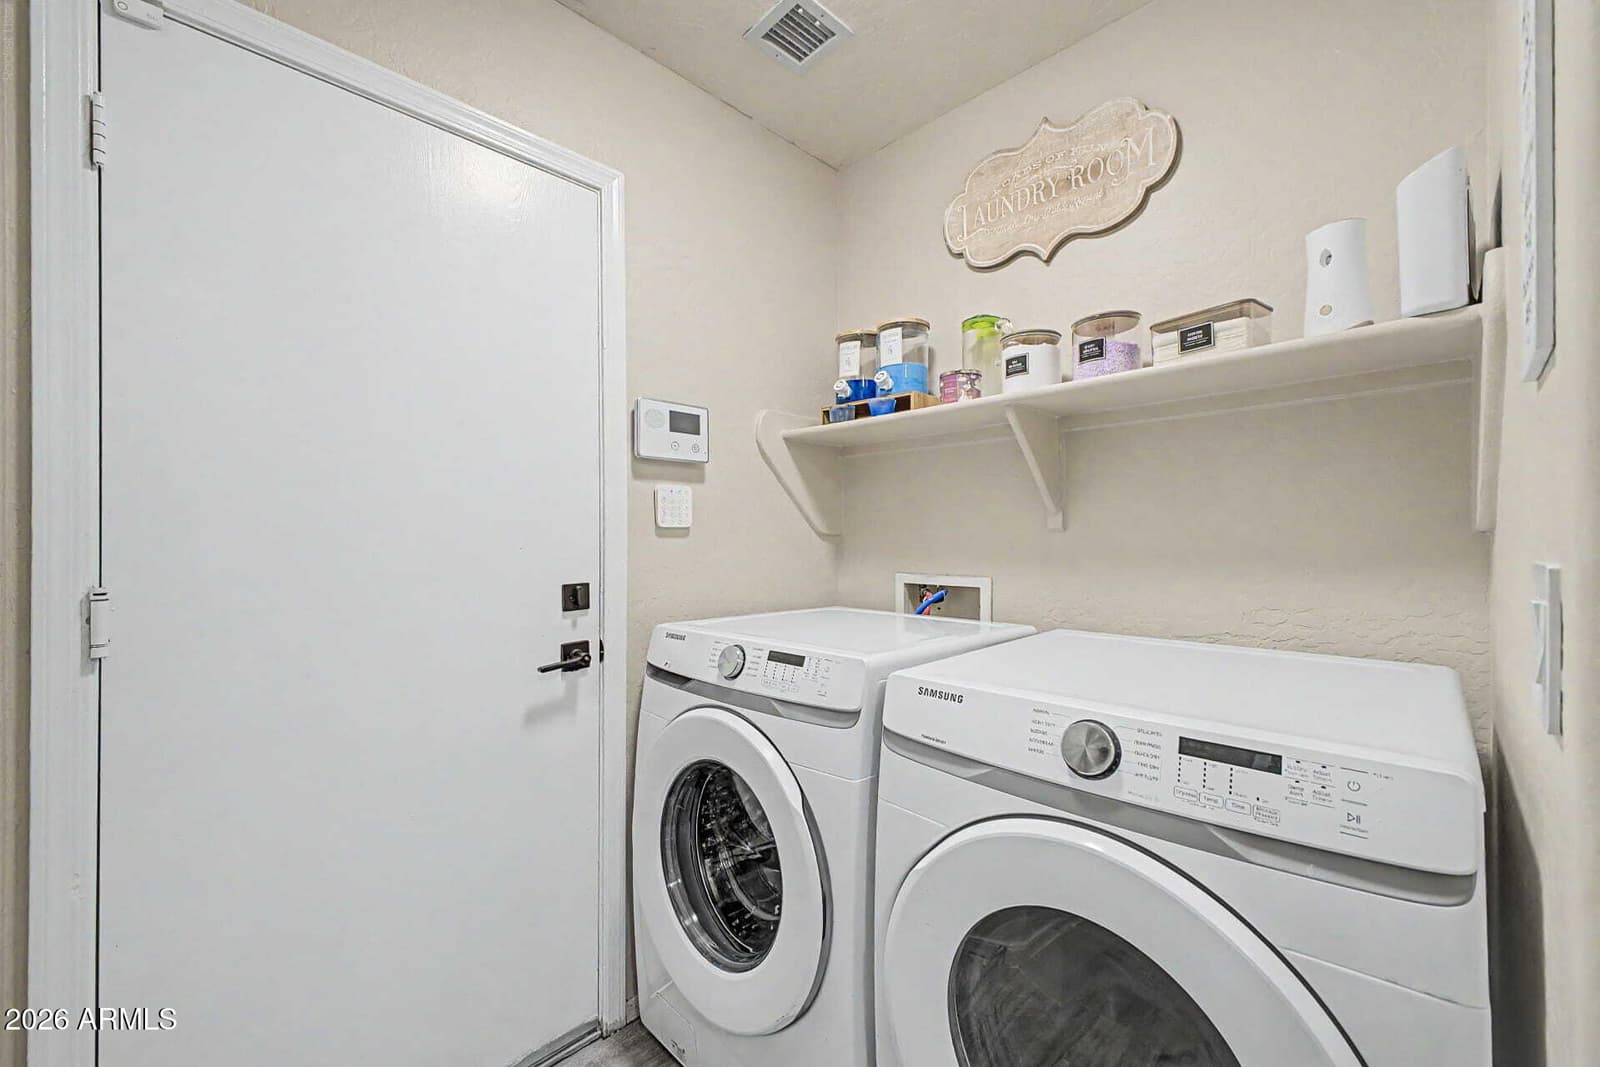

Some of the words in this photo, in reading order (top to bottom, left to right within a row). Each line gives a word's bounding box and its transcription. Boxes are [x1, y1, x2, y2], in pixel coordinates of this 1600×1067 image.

[957, 175, 1059, 242] LAUNDRY
[1066, 127, 1156, 190] ROOM
[917, 685, 964, 704] SAMSUNG
